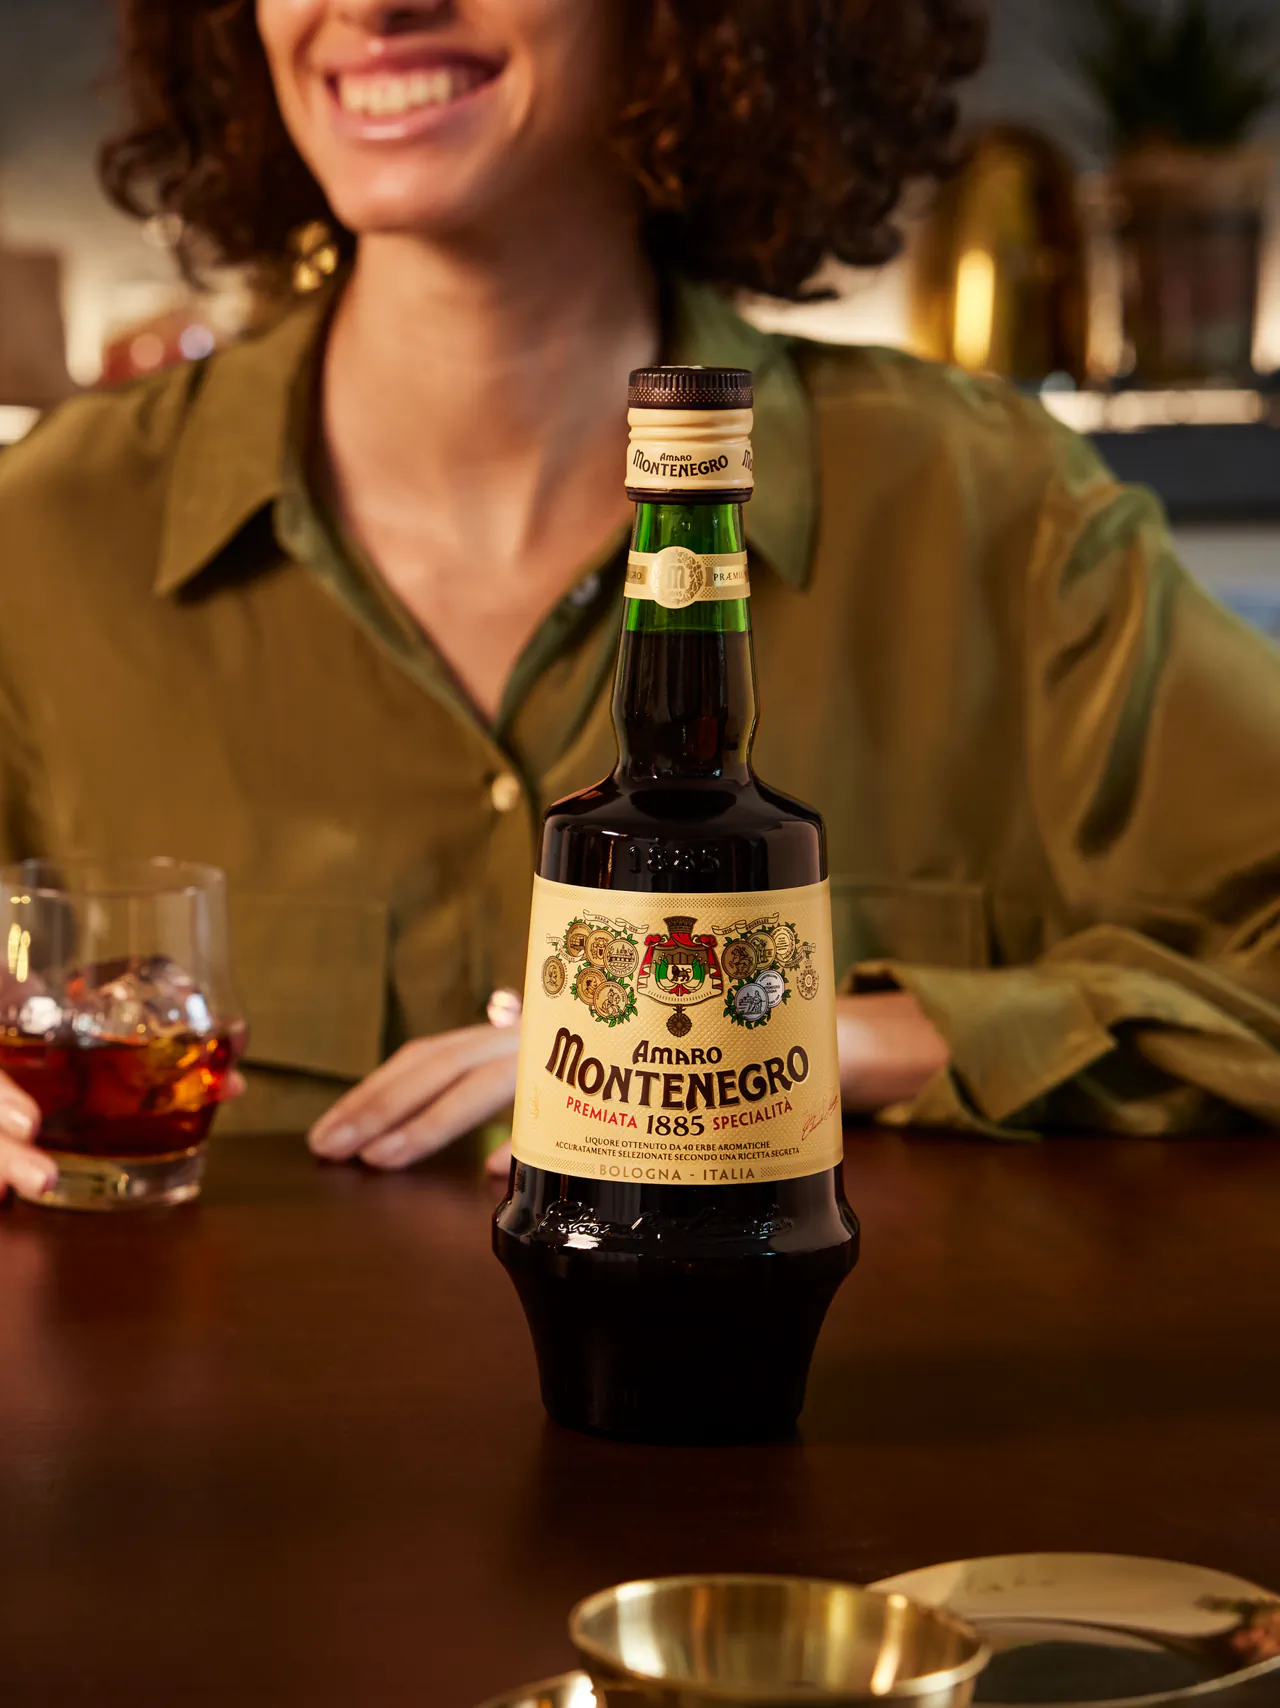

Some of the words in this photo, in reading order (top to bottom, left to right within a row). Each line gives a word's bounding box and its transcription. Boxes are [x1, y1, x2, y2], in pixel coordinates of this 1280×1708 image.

[633, 449, 729, 478] MONTENEGRO
[659, 452, 692, 462] AMARO
[632, 1039, 723, 1065] AMARO
[544, 1026, 810, 1113] MONTENEGRO
[566, 1095, 638, 1129] PREMIATA
[646, 1114, 705, 1137] 1885
[712, 1096, 793, 1131] SPECIALITÀ
[555, 1141, 616, 1157] ACCURATAMENTE
[618, 1149, 673, 1161] SELEZIONATE
[674, 1153, 718, 1161] SECONDO
[719, 1153, 737, 1161] UNA
[738, 1151, 770, 1160] RICETTA
[771, 1147, 800, 1158] SEGRETA
[585, 1136, 620, 1147] LIQUORE
[621, 1140, 667, 1150] OTTENUTO
[669, 1143, 682, 1151] DA
[683, 1143, 693, 1151] 40
[695, 1143, 716, 1151] ERBE
[718, 1141, 770, 1151] AROMATICHE
[599, 1164, 682, 1181] BOLOGNA
[703, 1167, 756, 1181] ITALIA
